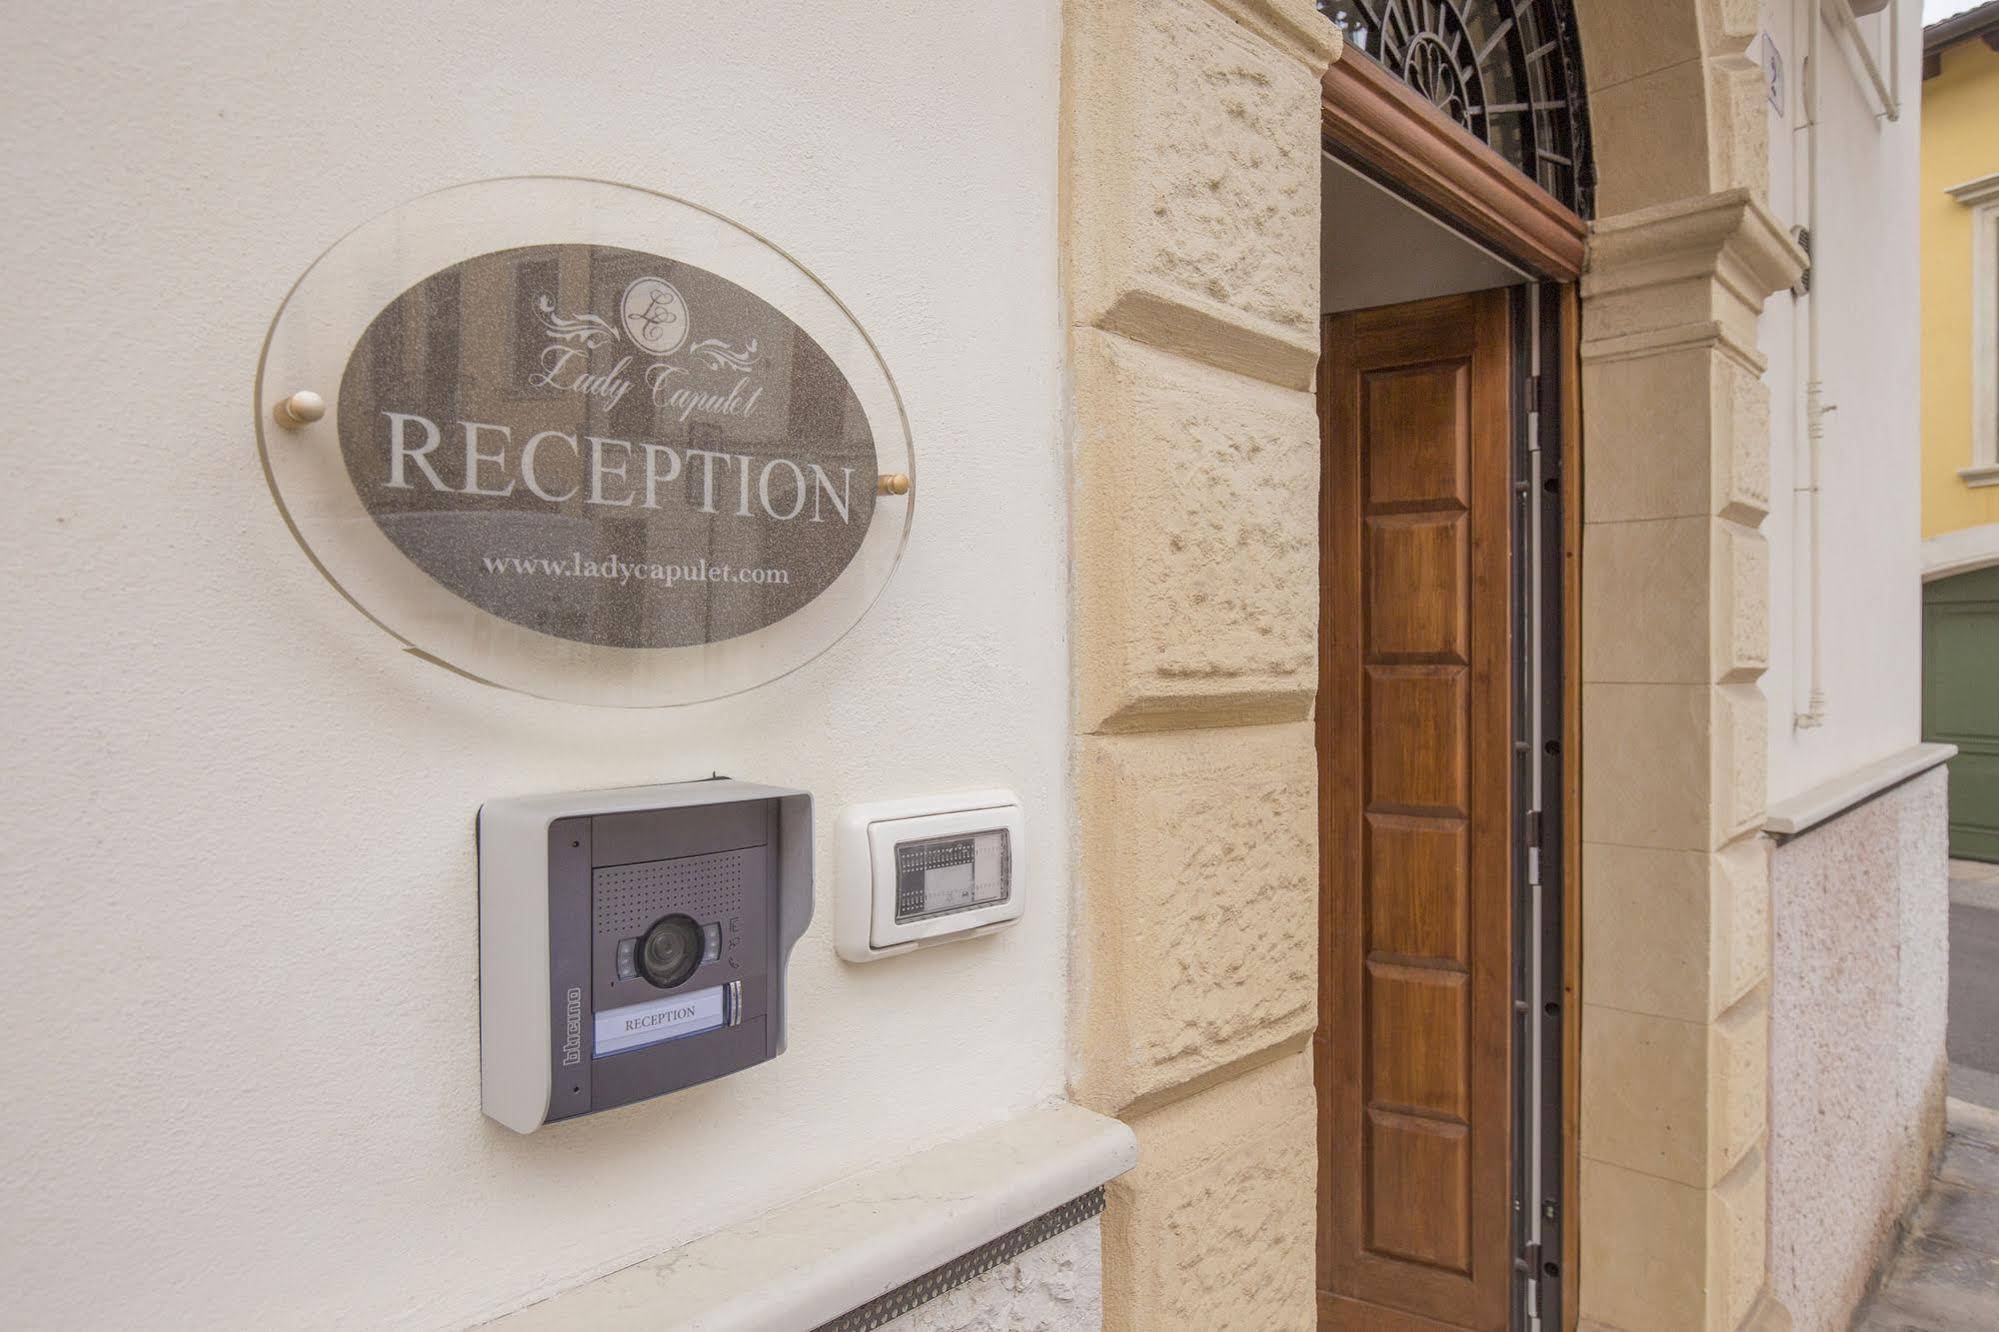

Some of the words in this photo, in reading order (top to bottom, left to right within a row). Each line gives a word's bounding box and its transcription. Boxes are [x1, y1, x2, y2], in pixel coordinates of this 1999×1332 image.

[528, 344, 633, 413] Lady
[645, 363, 764, 422] Capulet
[380, 408, 855, 526] RECEPTION
[483, 551, 790, 587] www.ladycapulet.com
[563, 986, 581, 1066] bticino
[625, 1005, 696, 1032] RECEPTION
